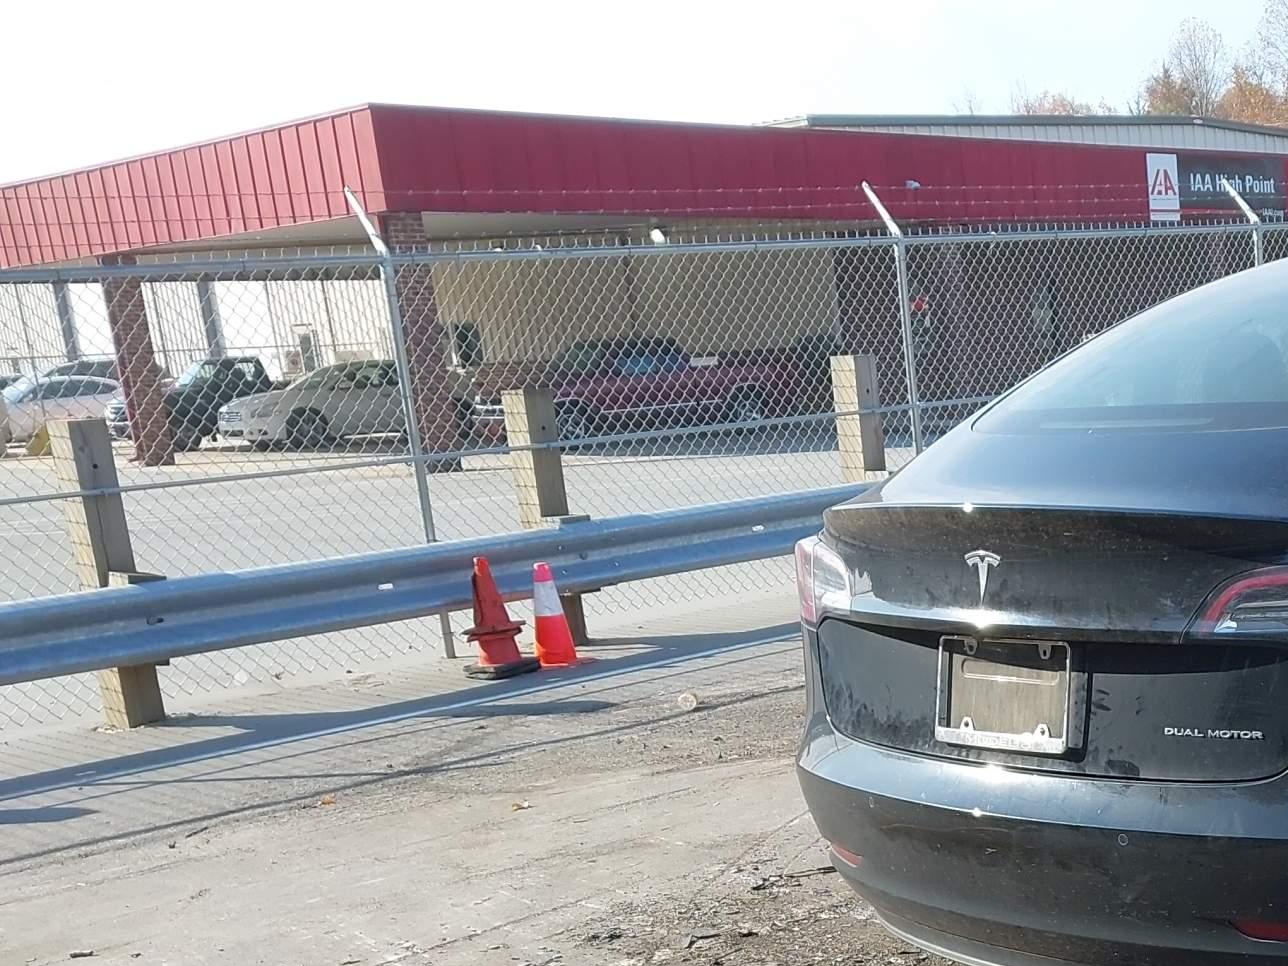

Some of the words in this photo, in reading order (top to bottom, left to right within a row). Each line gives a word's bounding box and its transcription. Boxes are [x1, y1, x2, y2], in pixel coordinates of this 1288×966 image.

[1189, 172, 1213, 192] IAA
[1246, 175, 1276, 194] Point
[1164, 727, 1204, 737] DUAL
[1207, 729, 1263, 739] MOTOR
